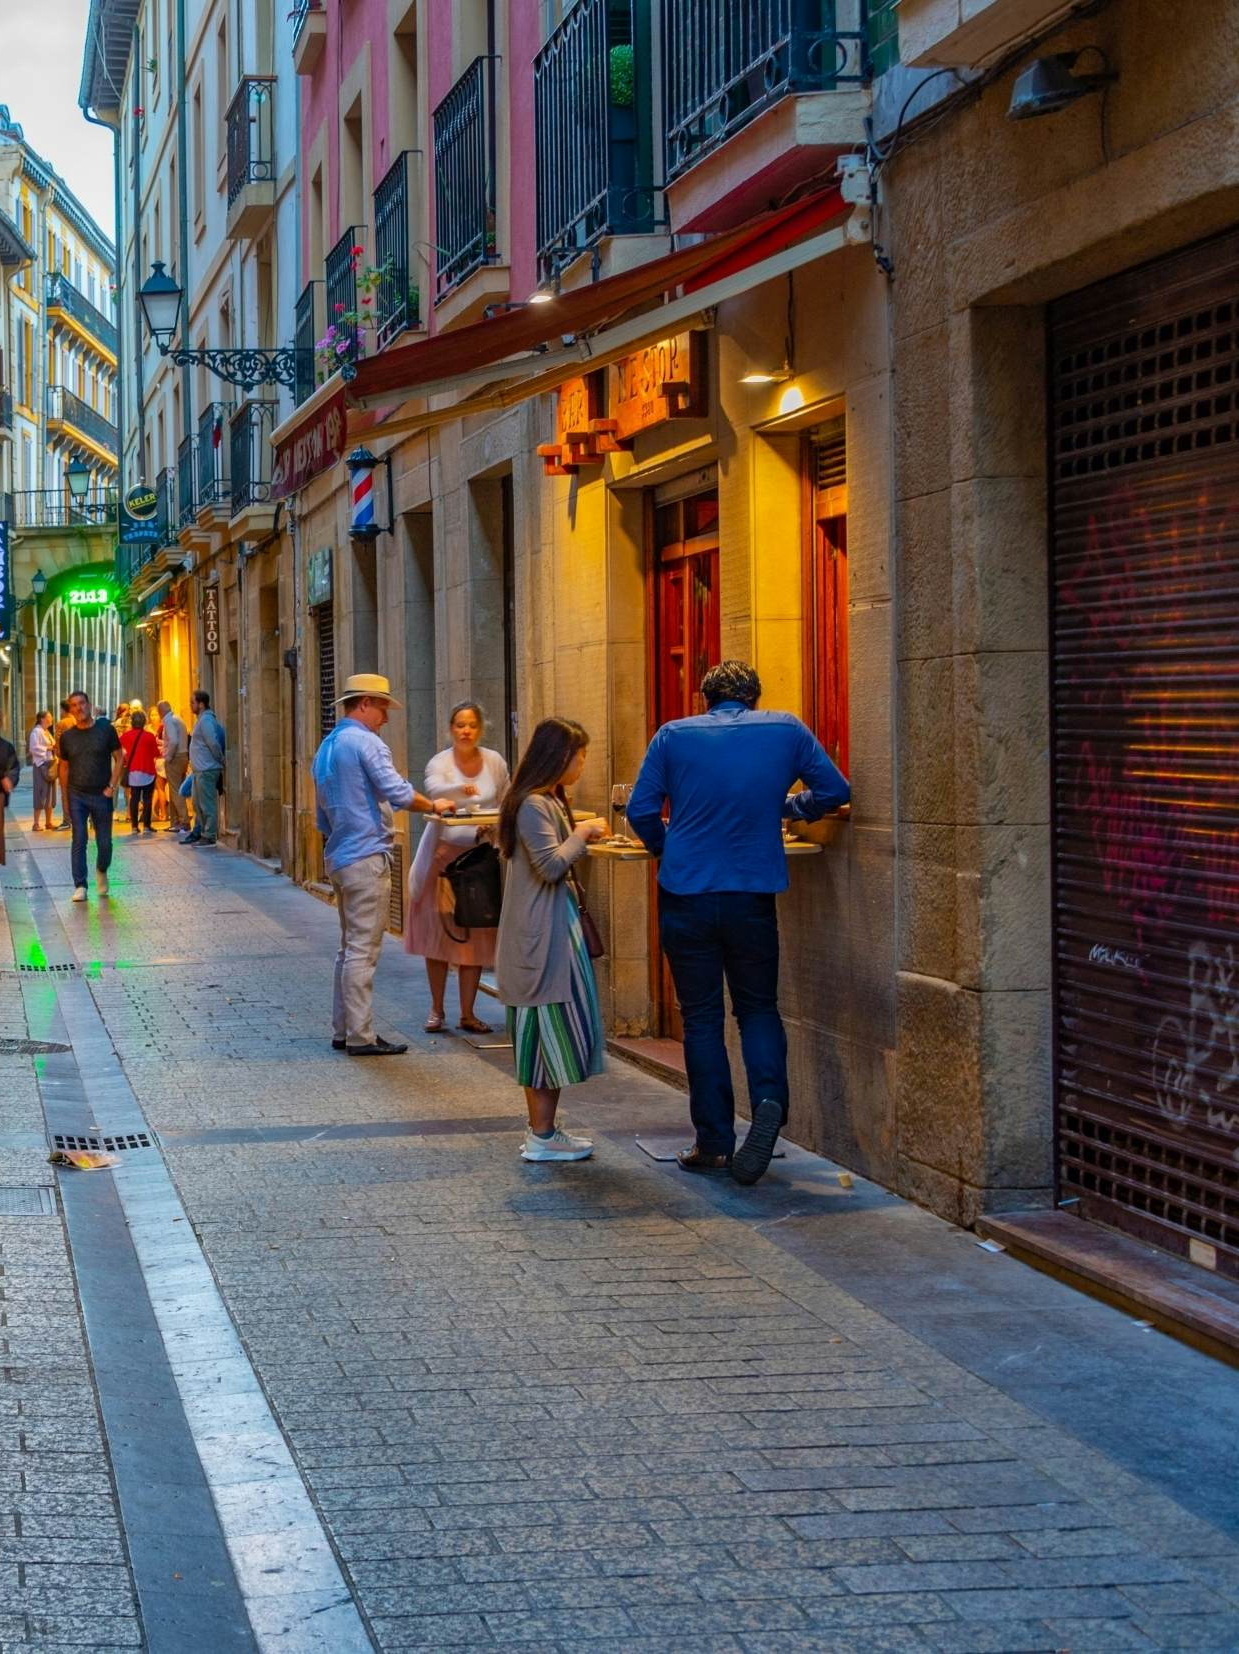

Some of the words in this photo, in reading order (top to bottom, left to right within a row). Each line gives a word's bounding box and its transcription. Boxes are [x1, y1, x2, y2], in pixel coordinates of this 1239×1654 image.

[617, 336, 679, 404] NESTOR
[128, 493, 158, 509] KELER
[206, 589, 218, 652] TATTOO
